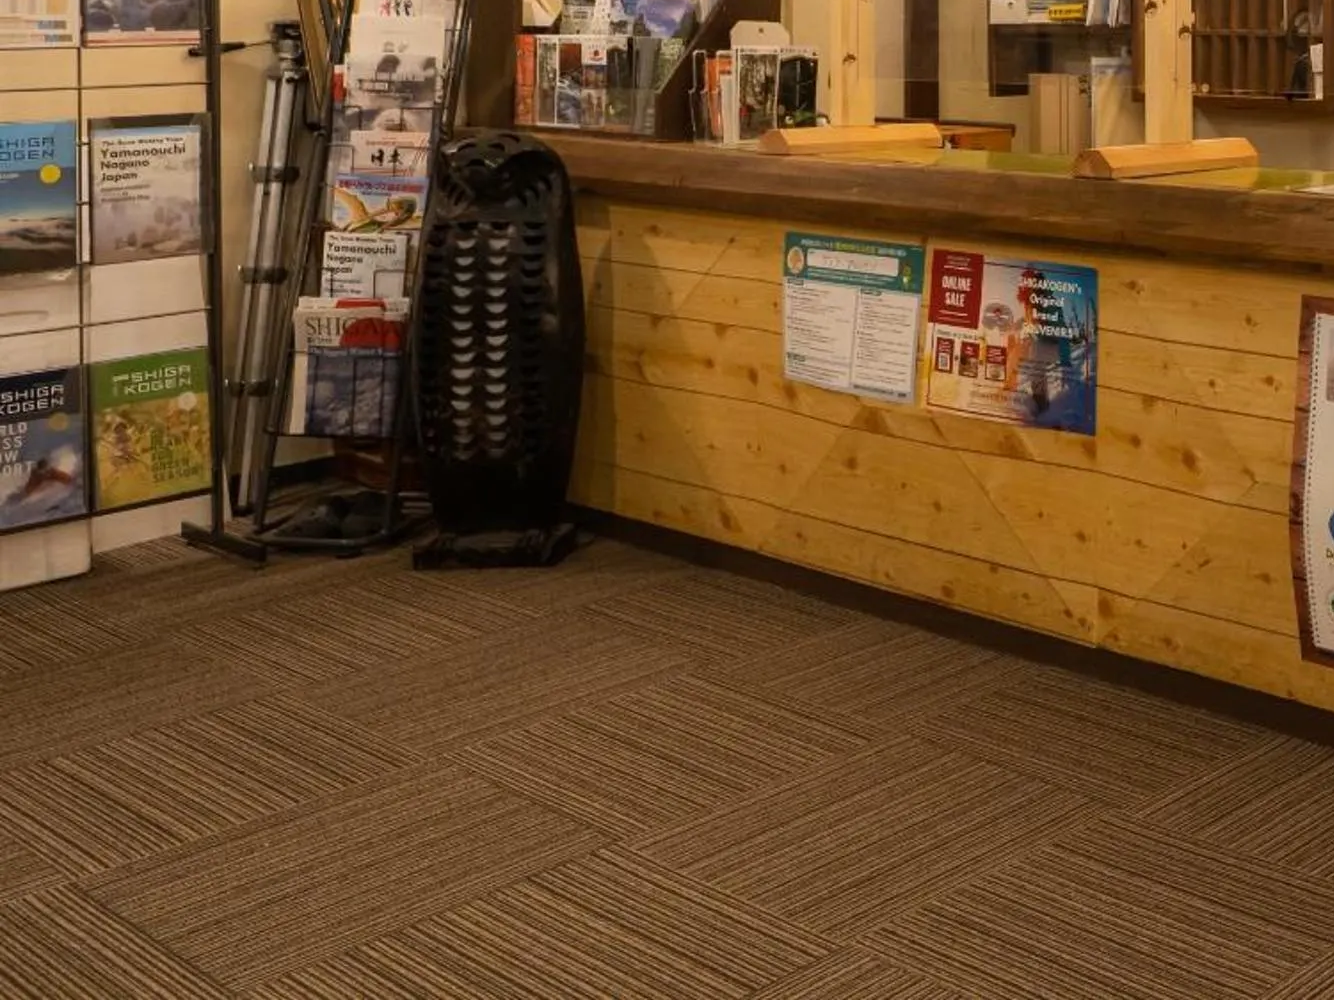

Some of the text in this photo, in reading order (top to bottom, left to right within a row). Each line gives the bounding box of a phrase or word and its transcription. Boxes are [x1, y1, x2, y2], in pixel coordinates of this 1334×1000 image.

[0, 149, 55, 162] OGEN
[101, 143, 186, 159] Yamanouchi
[100, 159, 150, 171] Nagano
[101, 172, 138, 183] Japan
[327, 241, 397, 255] Yamanouchi
[941, 275, 972, 292] ONLINE
[945, 292, 965, 308] SALE
[1028, 292, 1065, 308] Original
[131, 364, 192, 383] SHIGA
[1, 383, 65, 401] SHIGA
[124, 375, 192, 395] KOGEN
